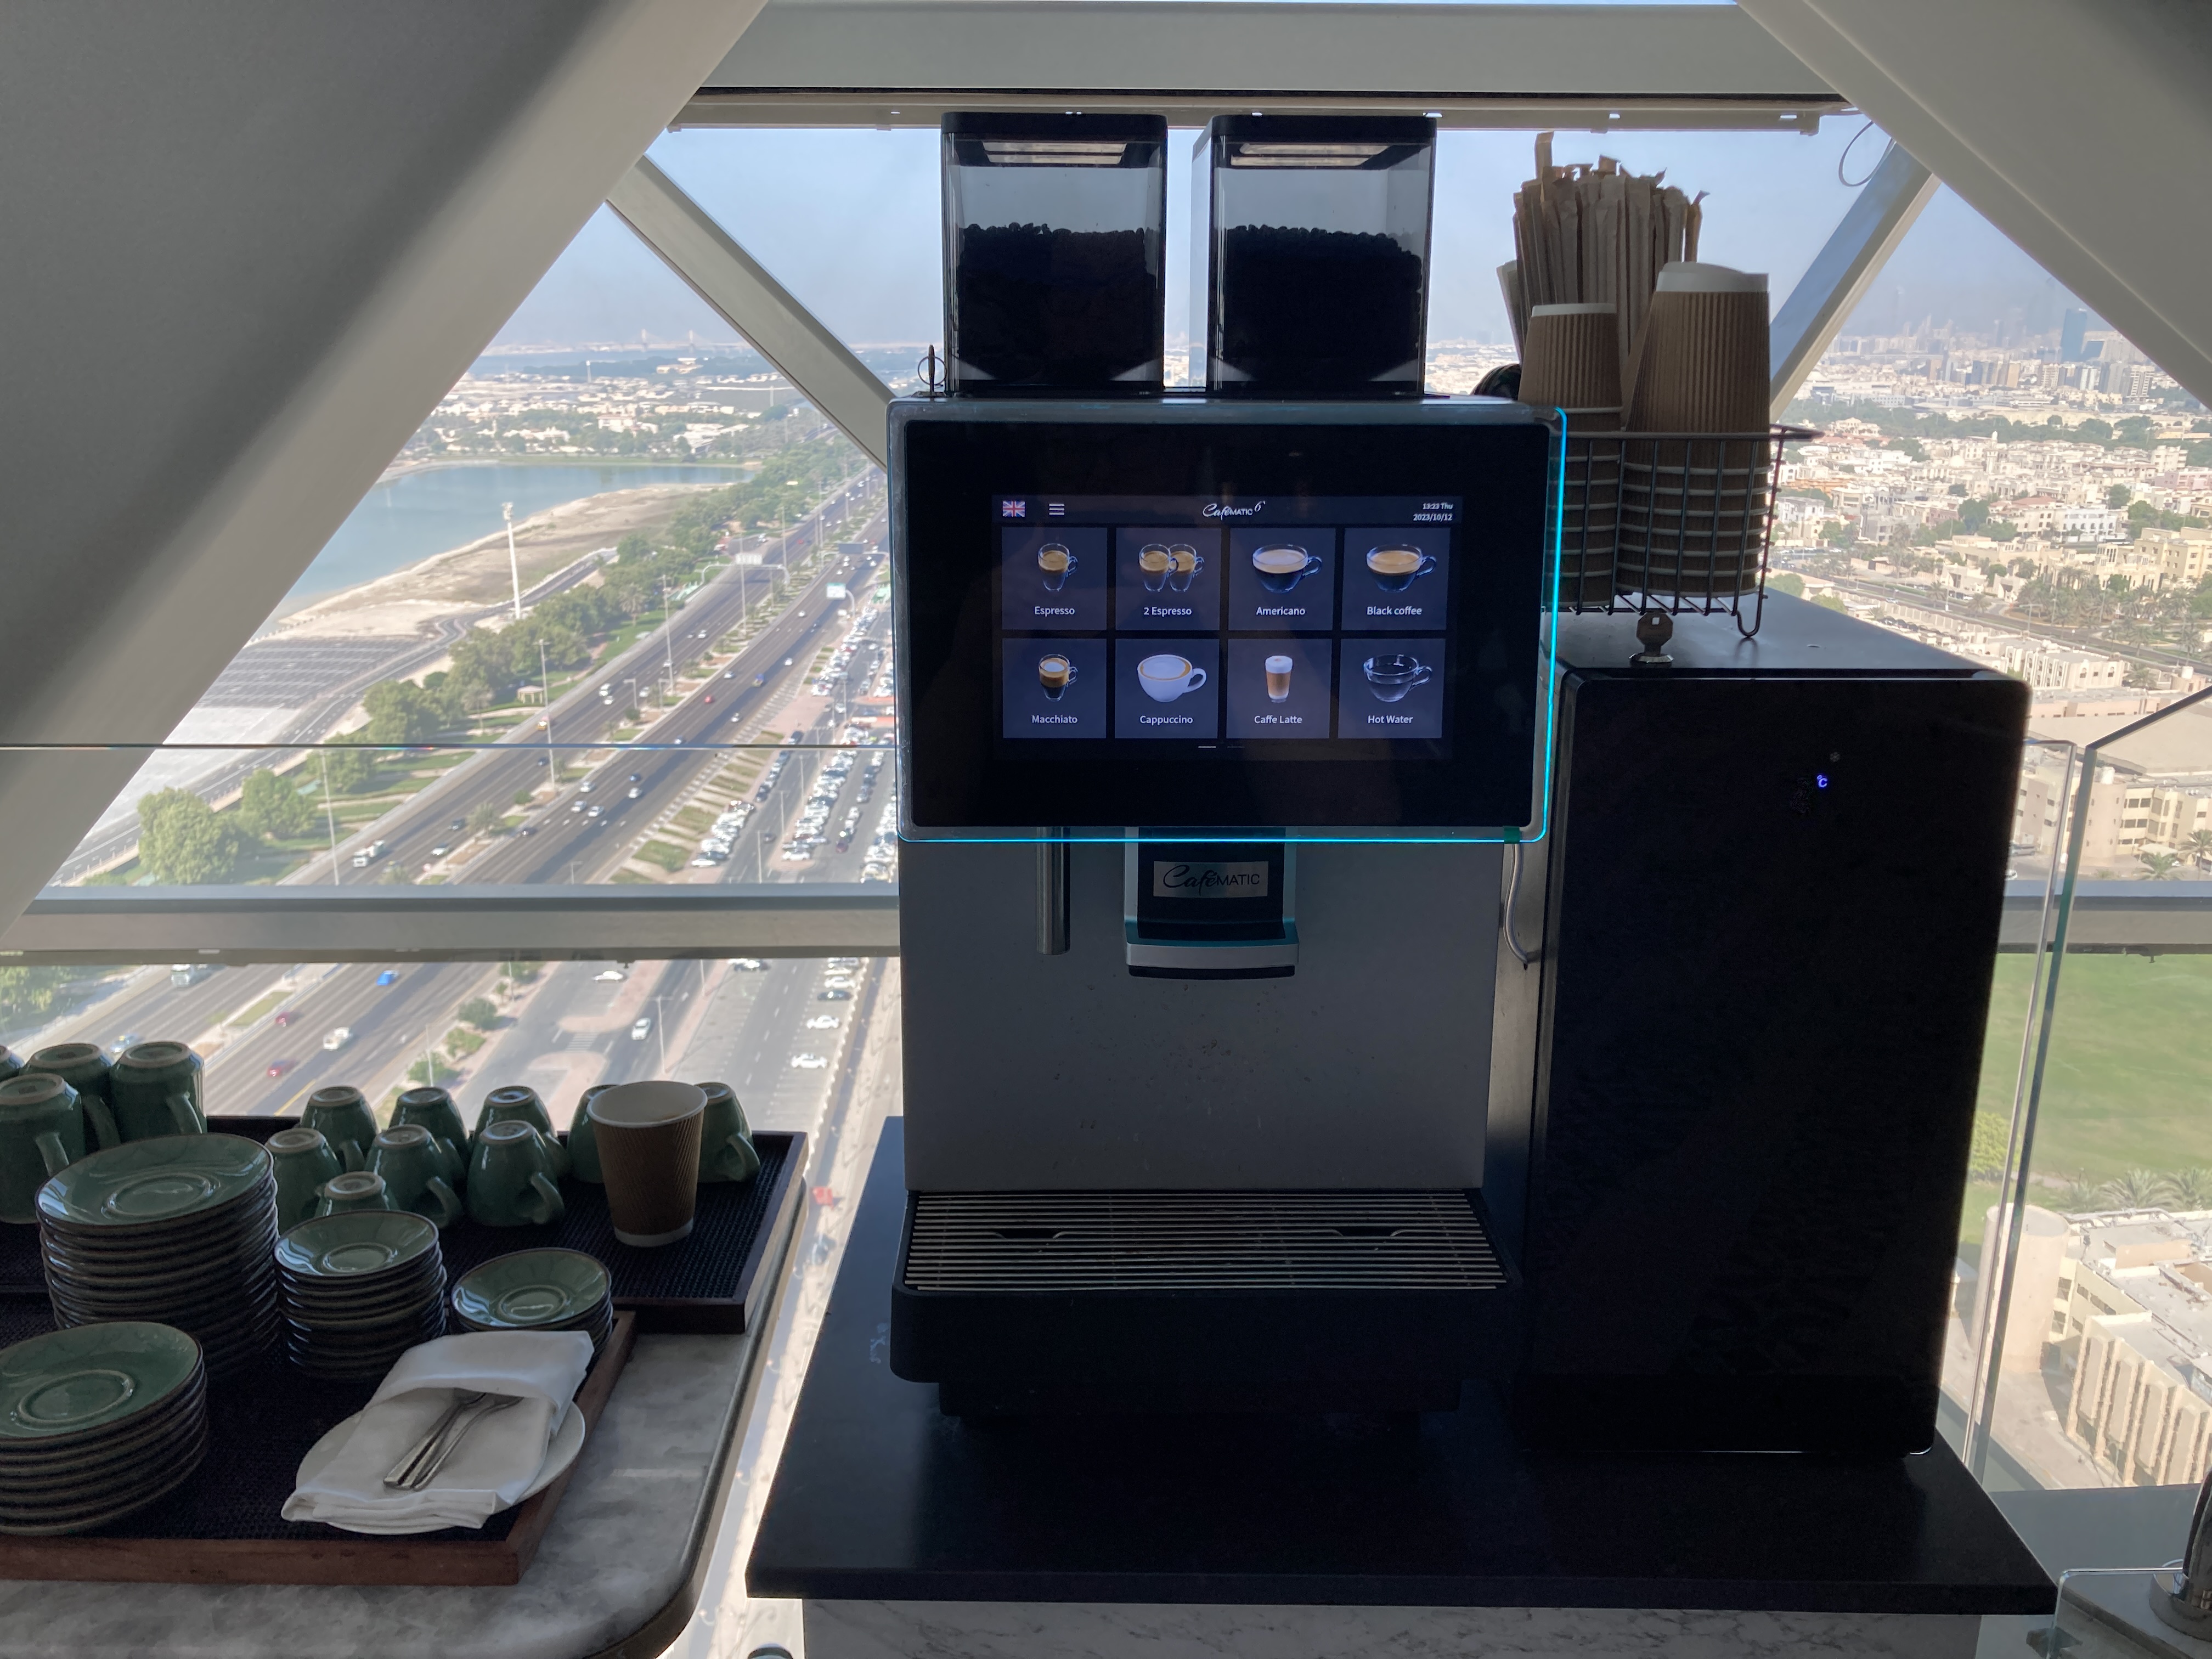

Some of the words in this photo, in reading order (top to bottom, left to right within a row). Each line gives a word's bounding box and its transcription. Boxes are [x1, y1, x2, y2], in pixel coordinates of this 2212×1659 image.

[1413, 513, 1453, 522] 2023/10/12
[1034, 606, 1075, 617] Espresso
[1143, 607, 1149, 616] 2
[1152, 606, 1192, 617] Espresso
[1256, 606, 1306, 616] Americano
[1367, 606, 1392, 615] Black
[1393, 606, 1422, 615] coffee
[1032, 714, 1078, 724] Macchiato
[1139, 715, 1193, 726] Cappuccino
[1254, 715, 1278, 724] Caffe
[1279, 715, 1302, 724] Latte
[1368, 715, 1385, 724] Hot
[1386, 715, 1414, 724] Water
